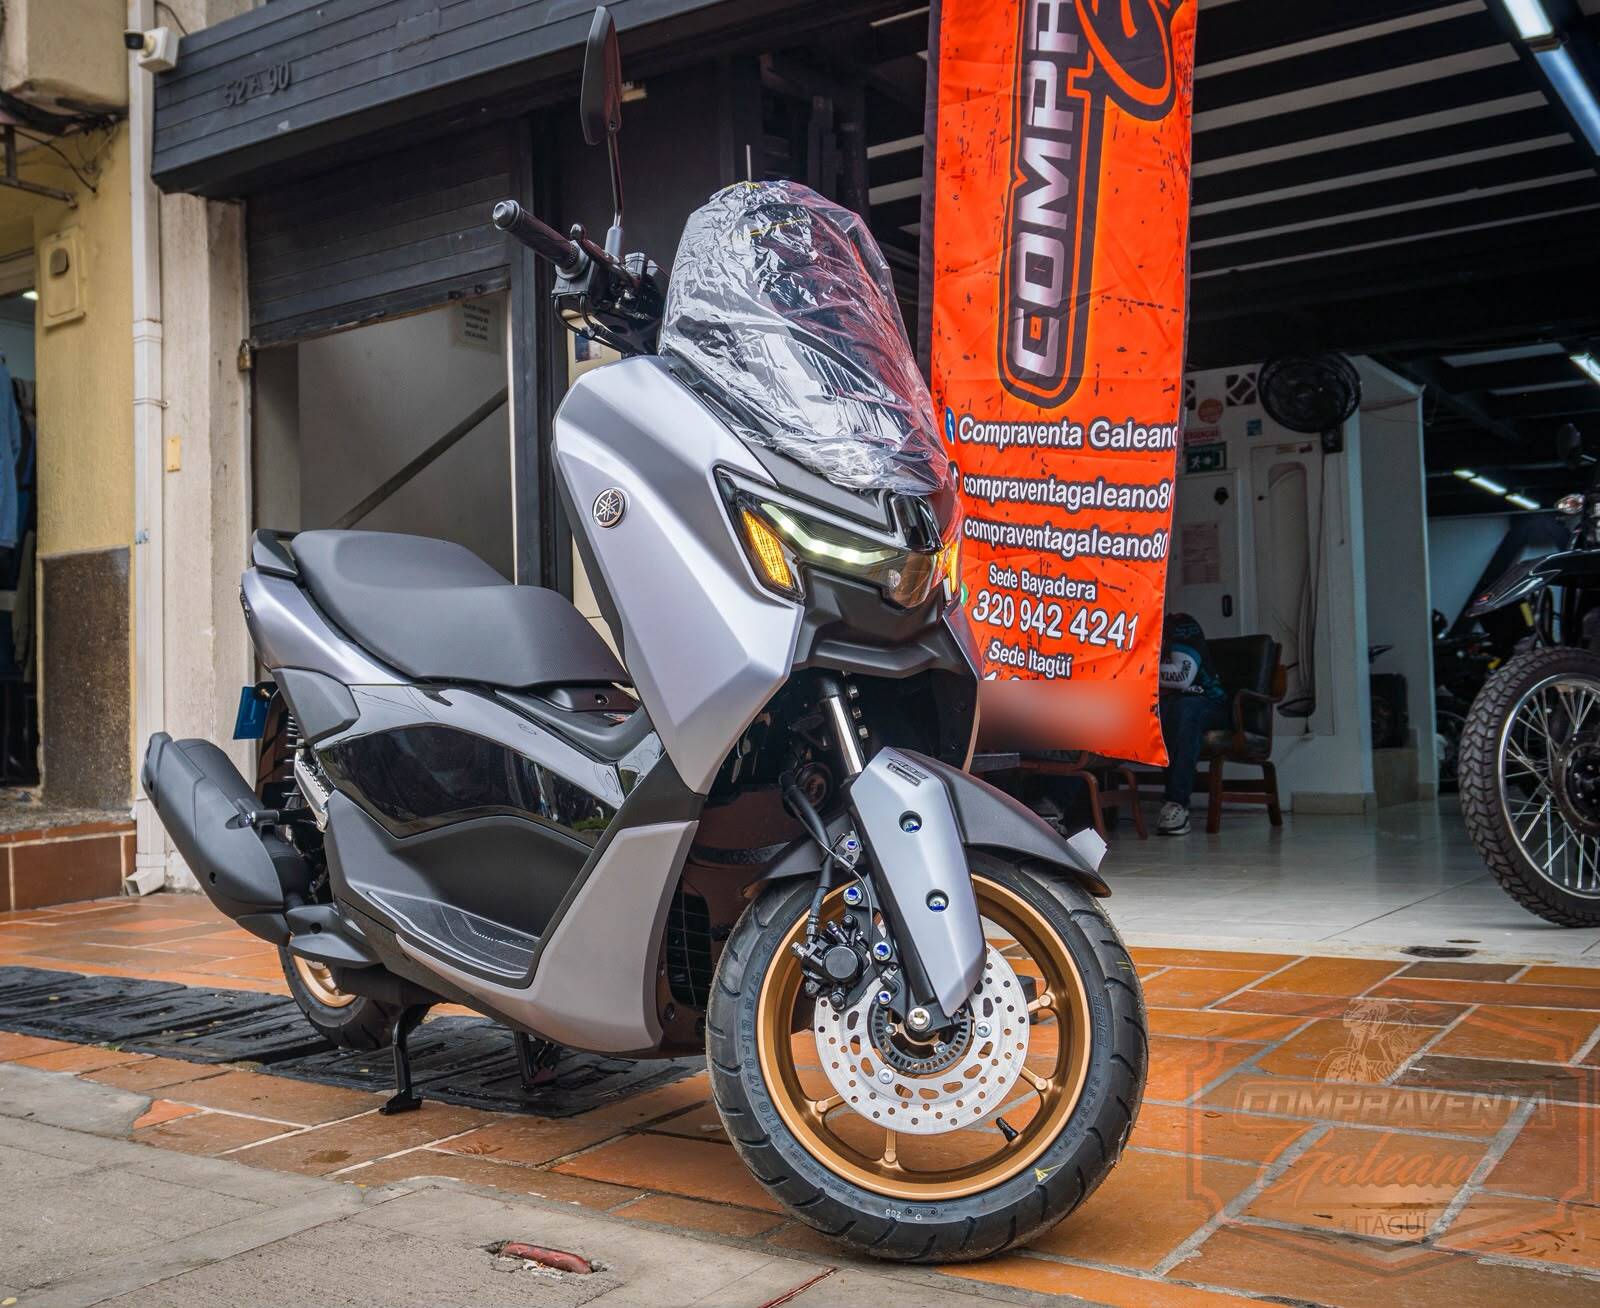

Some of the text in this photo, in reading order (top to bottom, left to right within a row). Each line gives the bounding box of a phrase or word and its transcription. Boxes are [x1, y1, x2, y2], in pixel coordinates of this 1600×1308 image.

[958, 416, 1083, 449] Compraventa
[964, 518, 1168, 559] compraventagaleano80
[989, 564, 1097, 600] Sede Bayadera
[972, 590, 1015, 628] 320
[1020, 600, 1063, 638] 942
[1070, 608, 1139, 650] 4241
[989, 641, 1072, 678] Sede Itagüí
